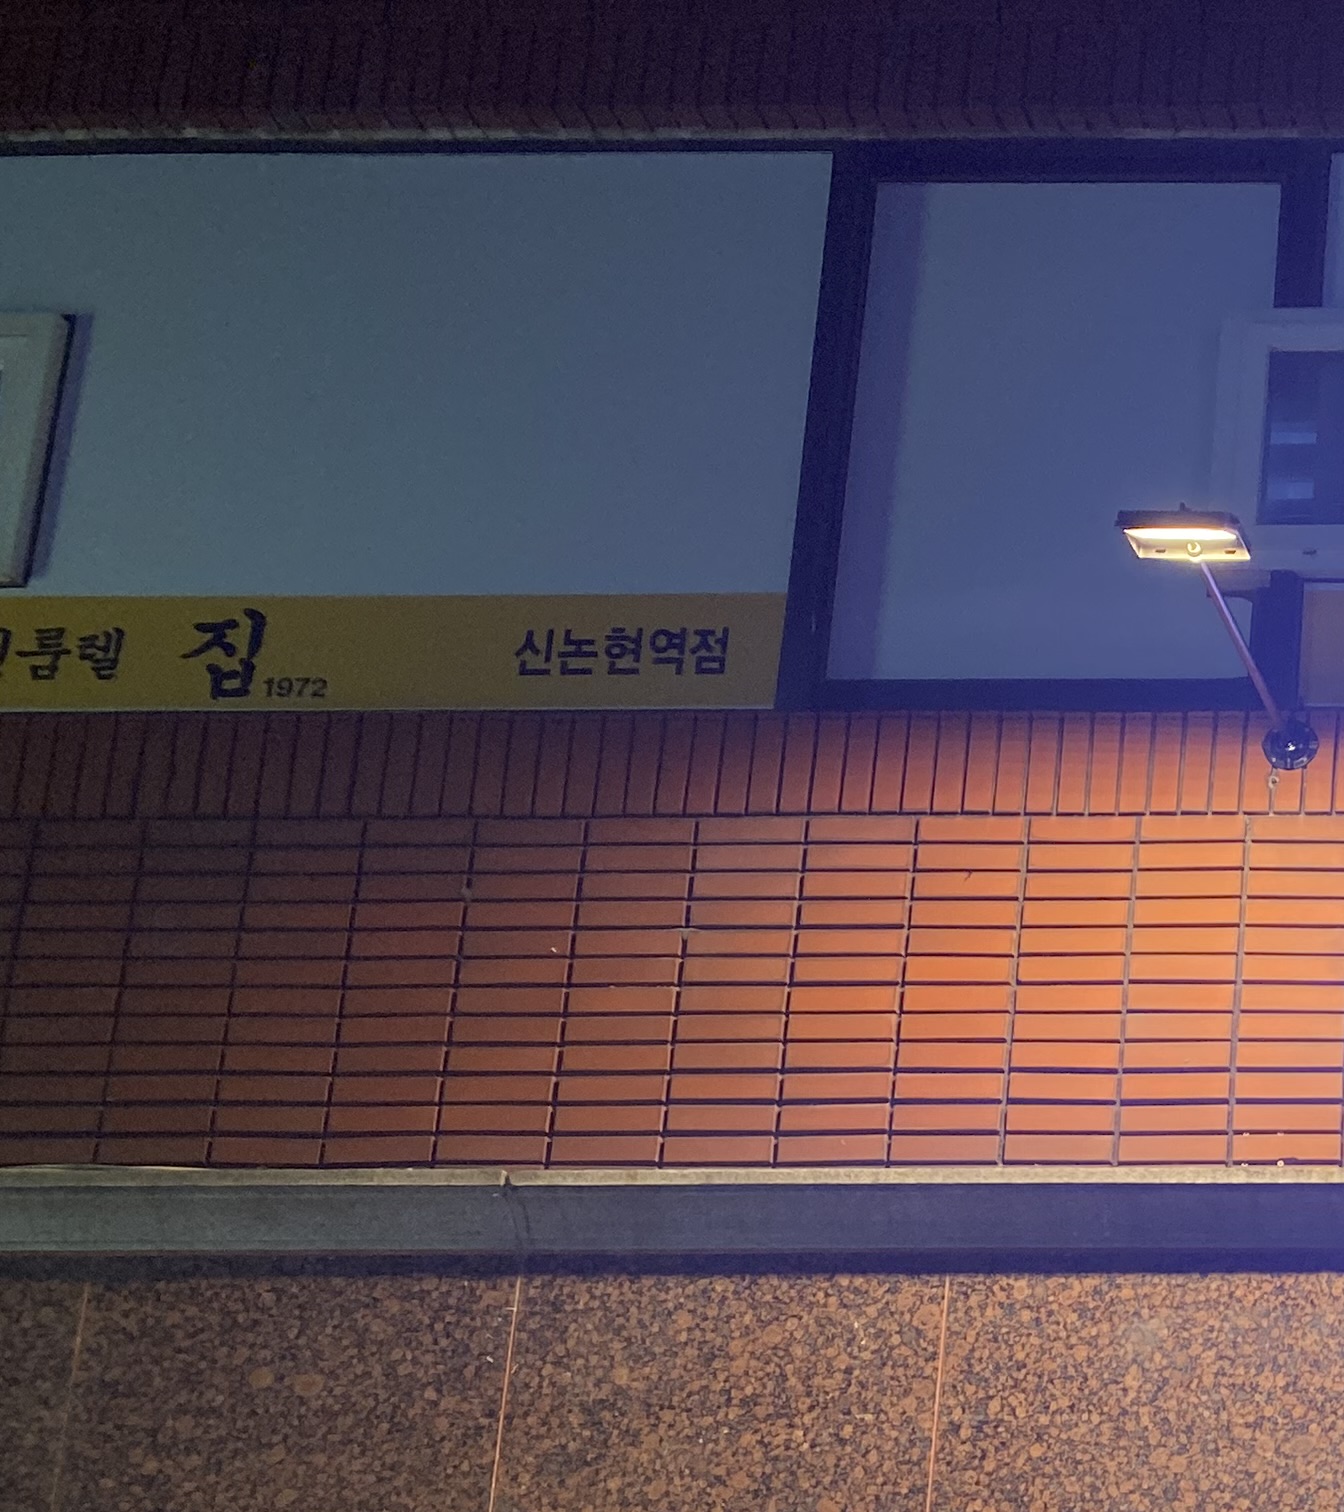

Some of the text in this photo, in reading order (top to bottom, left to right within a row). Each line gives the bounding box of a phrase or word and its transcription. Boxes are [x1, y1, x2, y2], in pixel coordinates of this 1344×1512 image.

[0, 608, 329, 701] 룸텔 집 1972
[511, 626, 731, 679] 신논현역점
